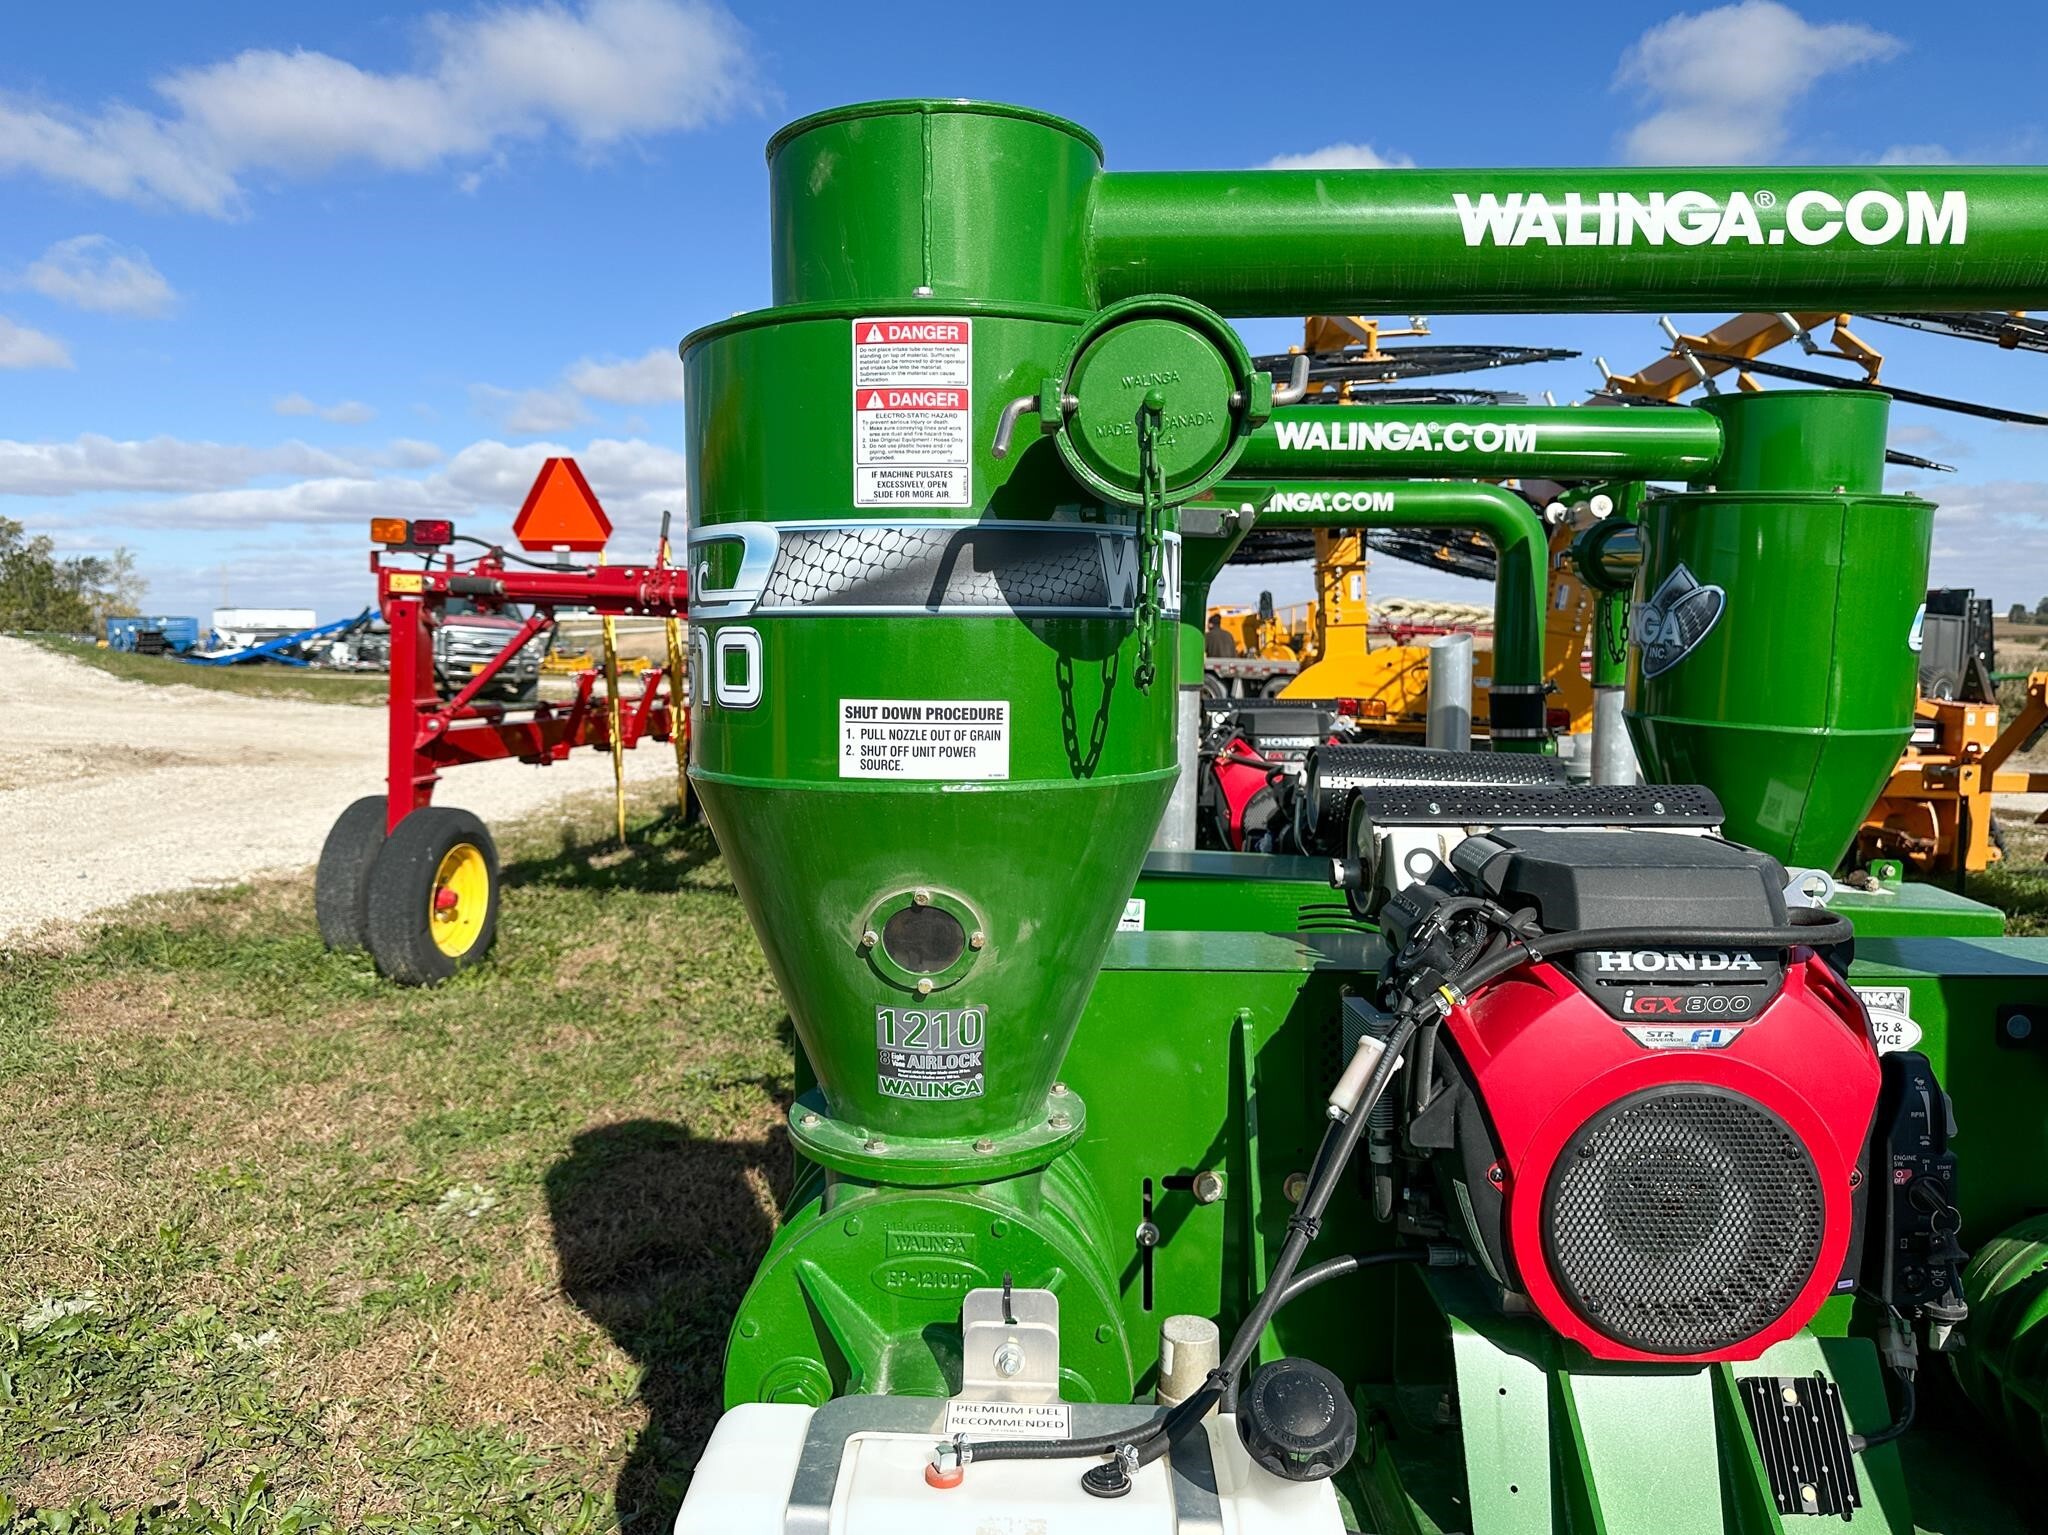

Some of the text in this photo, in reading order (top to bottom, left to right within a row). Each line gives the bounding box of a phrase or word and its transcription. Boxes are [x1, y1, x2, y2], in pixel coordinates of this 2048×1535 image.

[889, 326, 959, 340] DANGER
[1121, 370, 1180, 389] WALINGA
[889, 392, 959, 407] DANGER
[1095, 421, 1132, 438] MADE
[1649, 647, 1667, 659] INC.
[845, 706, 1003, 721] SHUT DOWN PROCEDURE
[846, 728, 1001, 741] 1. PULL NOZZLE OUT OF GRAIN
[1260, 738, 1314, 747] HONDA
[846, 745, 976, 758] 2. SHUT OFF UNIT POWER
[860, 759, 904, 771] SOURCE.
[1596, 951, 1762, 972] HONDA
[1685, 995, 1752, 1014] 800
[878, 1009, 983, 1049] 1210
[1894, 1023, 1903, 1032] &
[1691, 1029, 1721, 1043] FI
[880, 1050, 982, 1070] 8 Eight AIRLOCK
[895, 1235, 966, 1253] WALINGA
[956, 1405, 1061, 1416] PREMIUM FUEL
[952, 1417, 1064, 1428] RECOMMENDED
